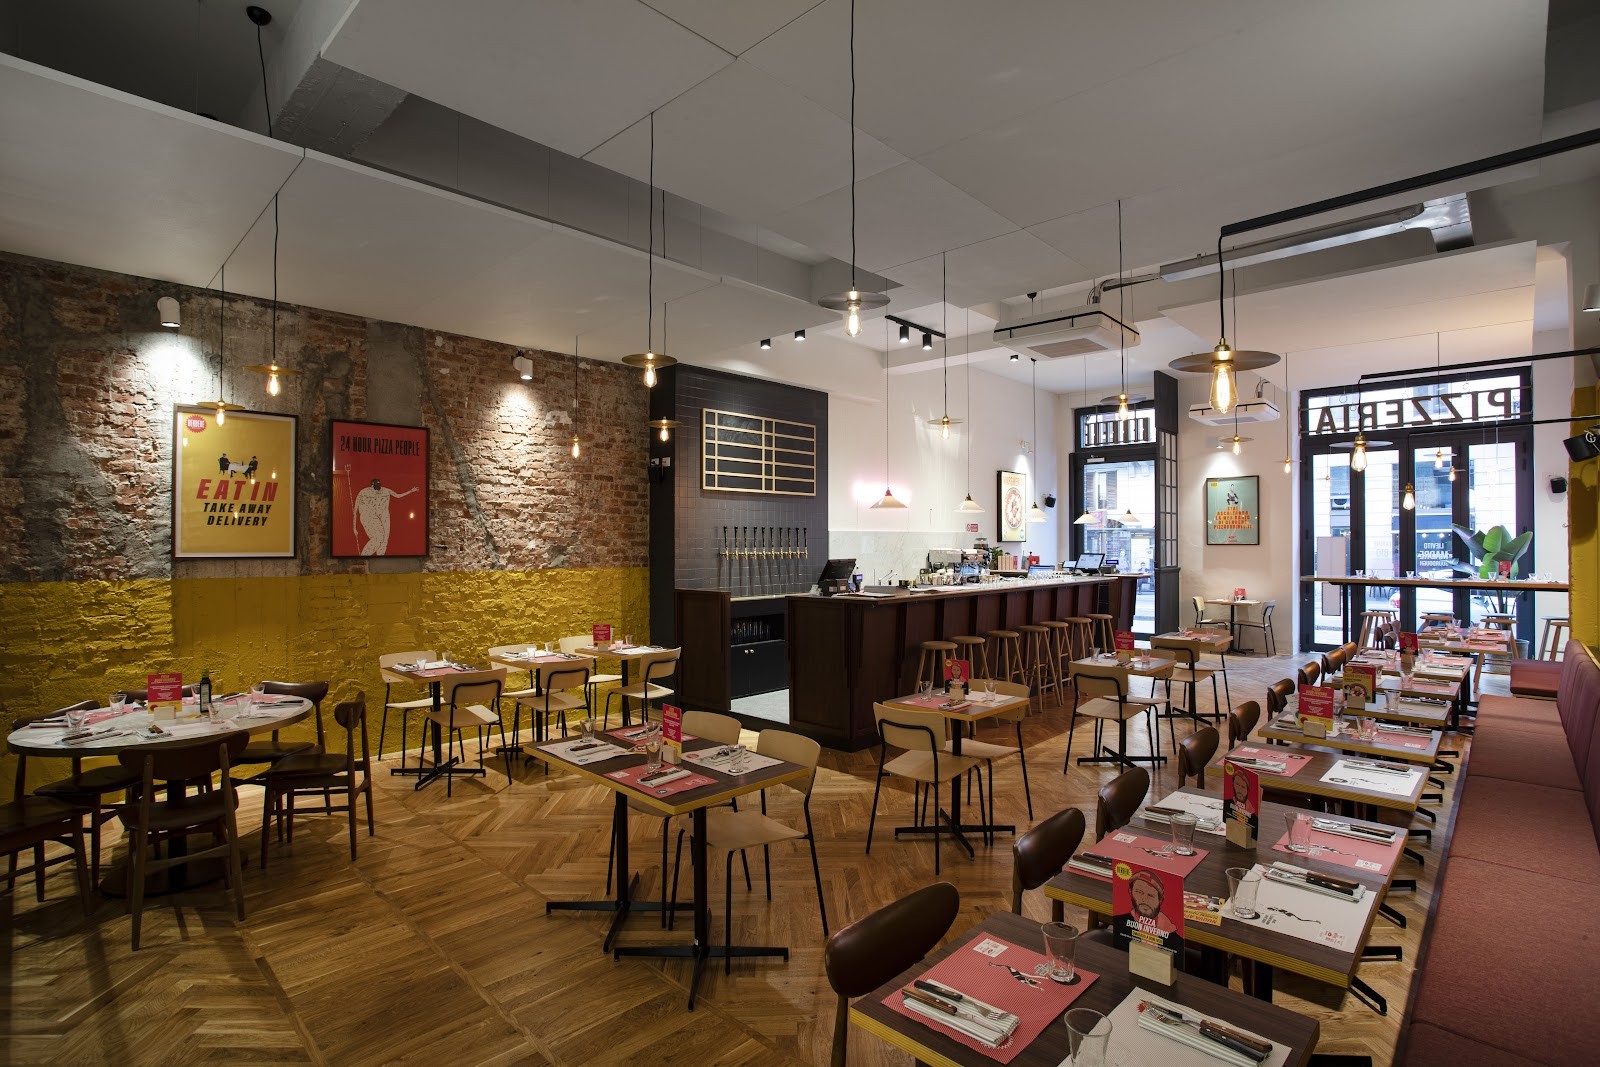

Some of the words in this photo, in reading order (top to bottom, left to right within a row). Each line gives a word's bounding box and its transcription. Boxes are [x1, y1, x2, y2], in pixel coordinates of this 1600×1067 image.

[340, 435, 350, 452] 24
[352, 436, 372, 453] HOUR
[374, 438, 393, 454] PIZZA
[395, 439, 420, 456] PEOPLE
[196, 478, 247, 501] EAT
[250, 481, 279, 502] IN
[203, 502, 235, 513] TAKE
[239, 503, 272, 514] AWAY
[206, 515, 268, 526] DELIVERY
[1126, 919, 1143, 932] BUON
[1143, 925, 1170, 940] INVERNO
[1138, 915, 1157, 928] PIZZA
